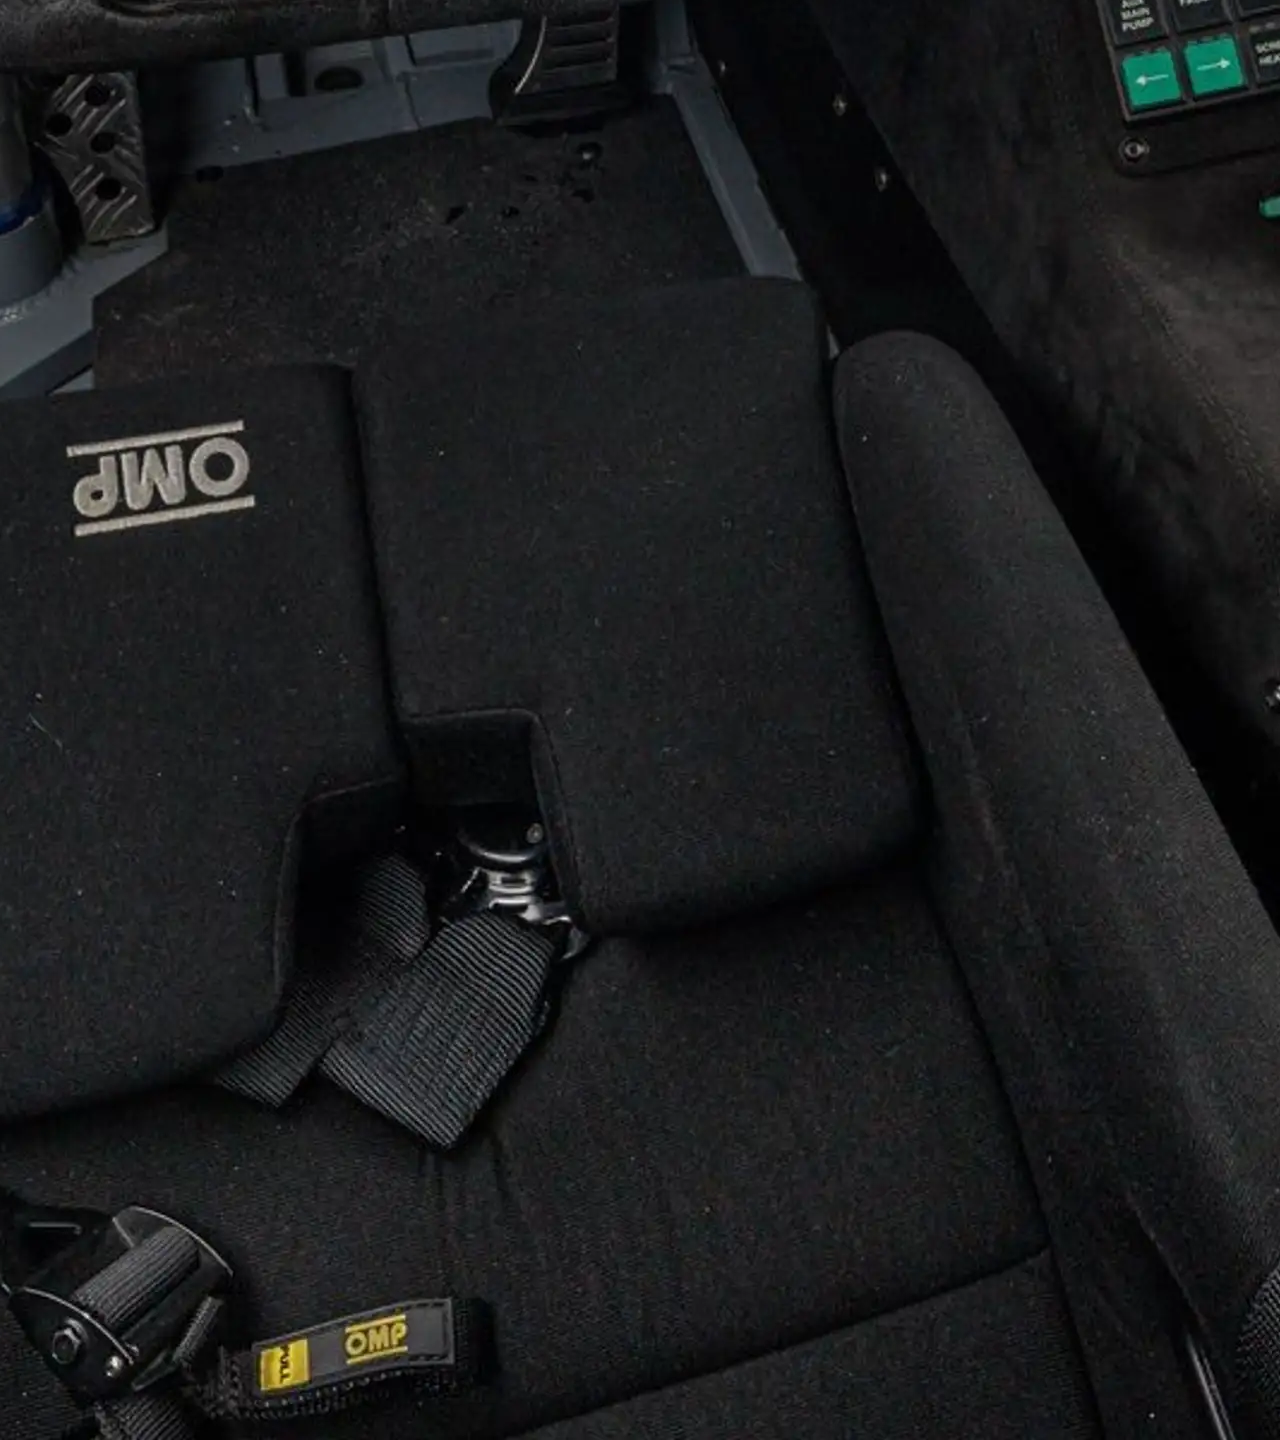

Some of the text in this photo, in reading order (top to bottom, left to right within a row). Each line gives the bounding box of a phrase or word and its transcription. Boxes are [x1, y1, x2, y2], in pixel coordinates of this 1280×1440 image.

[1121, 6, 1151, 21] MAIN
[1121, 17, 1156, 33] PUMP
[73, 436, 250, 517] OMP
[345, 1322, 408, 1357] OMP
